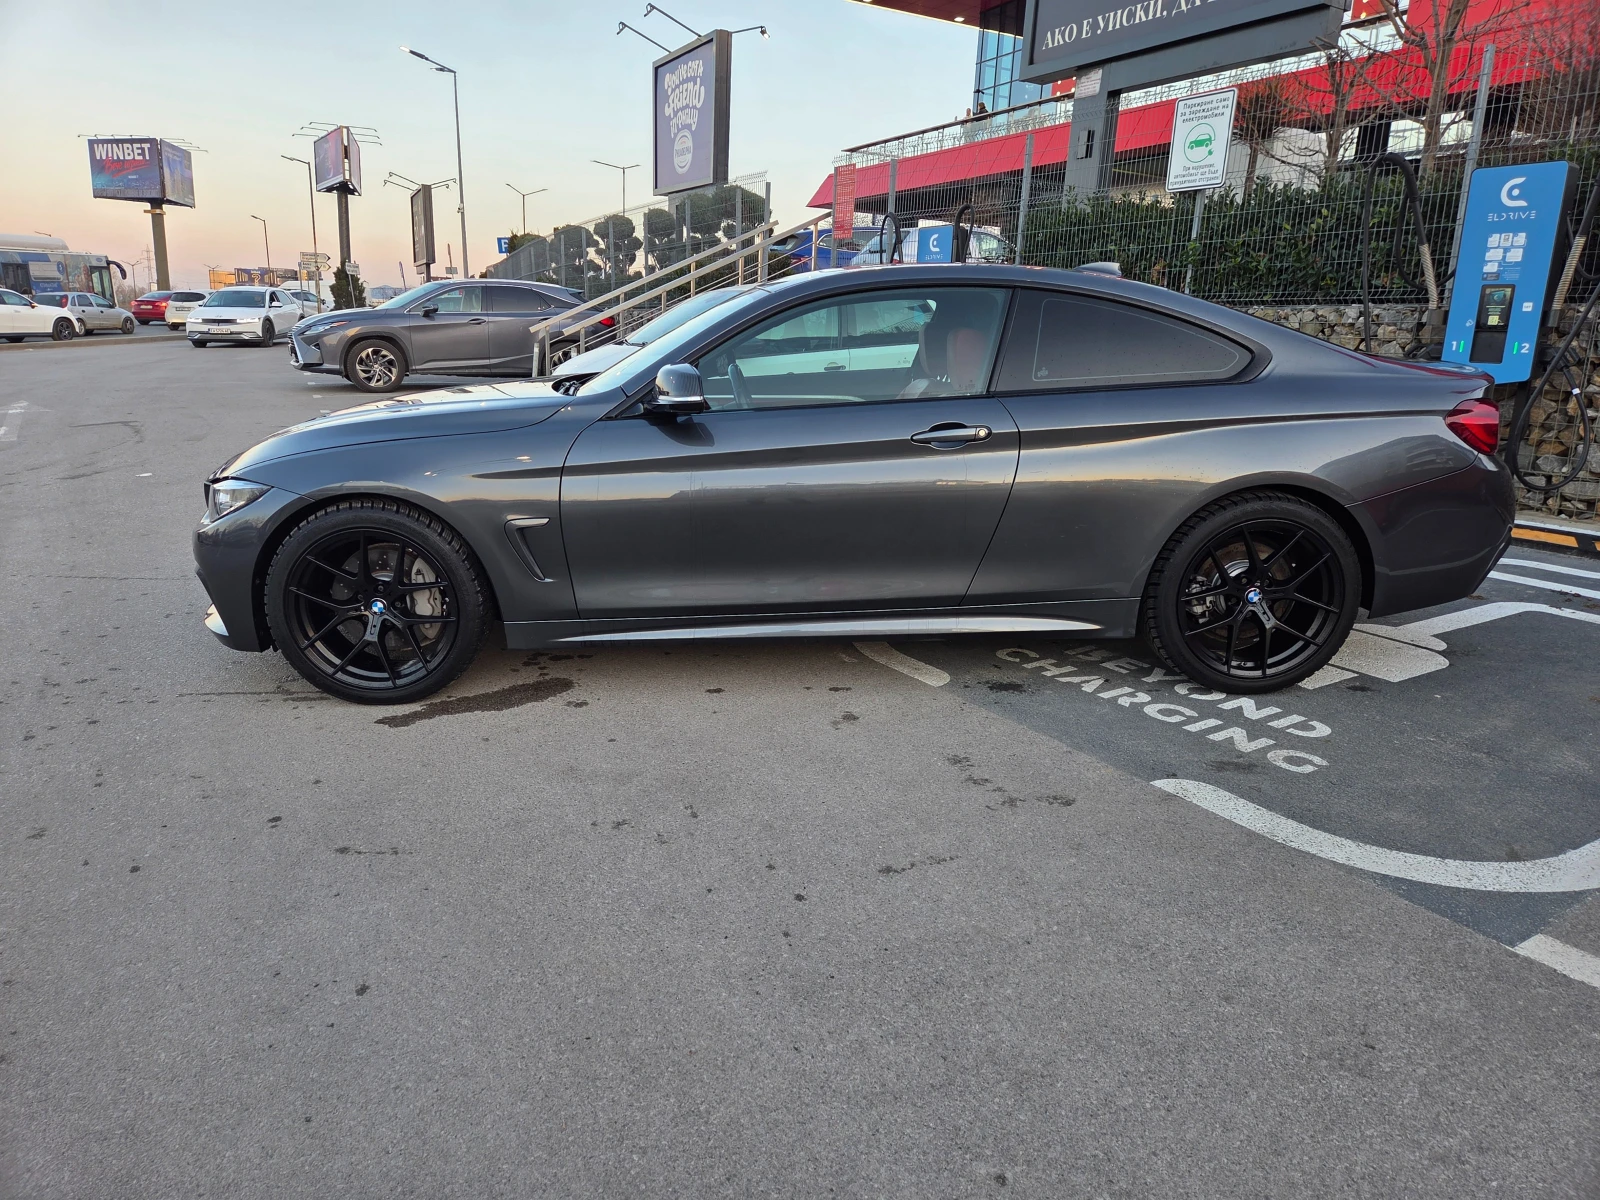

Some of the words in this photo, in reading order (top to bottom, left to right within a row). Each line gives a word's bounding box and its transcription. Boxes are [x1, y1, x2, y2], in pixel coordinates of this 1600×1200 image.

[1042, 23, 1077, 50] АКО
[1081, 18, 1092, 39] Е
[1096, 0, 1167, 35] УИСКИ,
[1184, 100, 1214, 109] Паркиране
[1189, 106, 1220, 116] зареждане
[1182, 112, 1225, 123] електромобили
[94, 143, 150, 160] WINBET
[1487, 210, 1536, 222] ELDRIVE
[1451, 341, 1458, 351] 1
[1520, 343, 1530, 353] 2
[995, 647, 1330, 774] CHARGING
